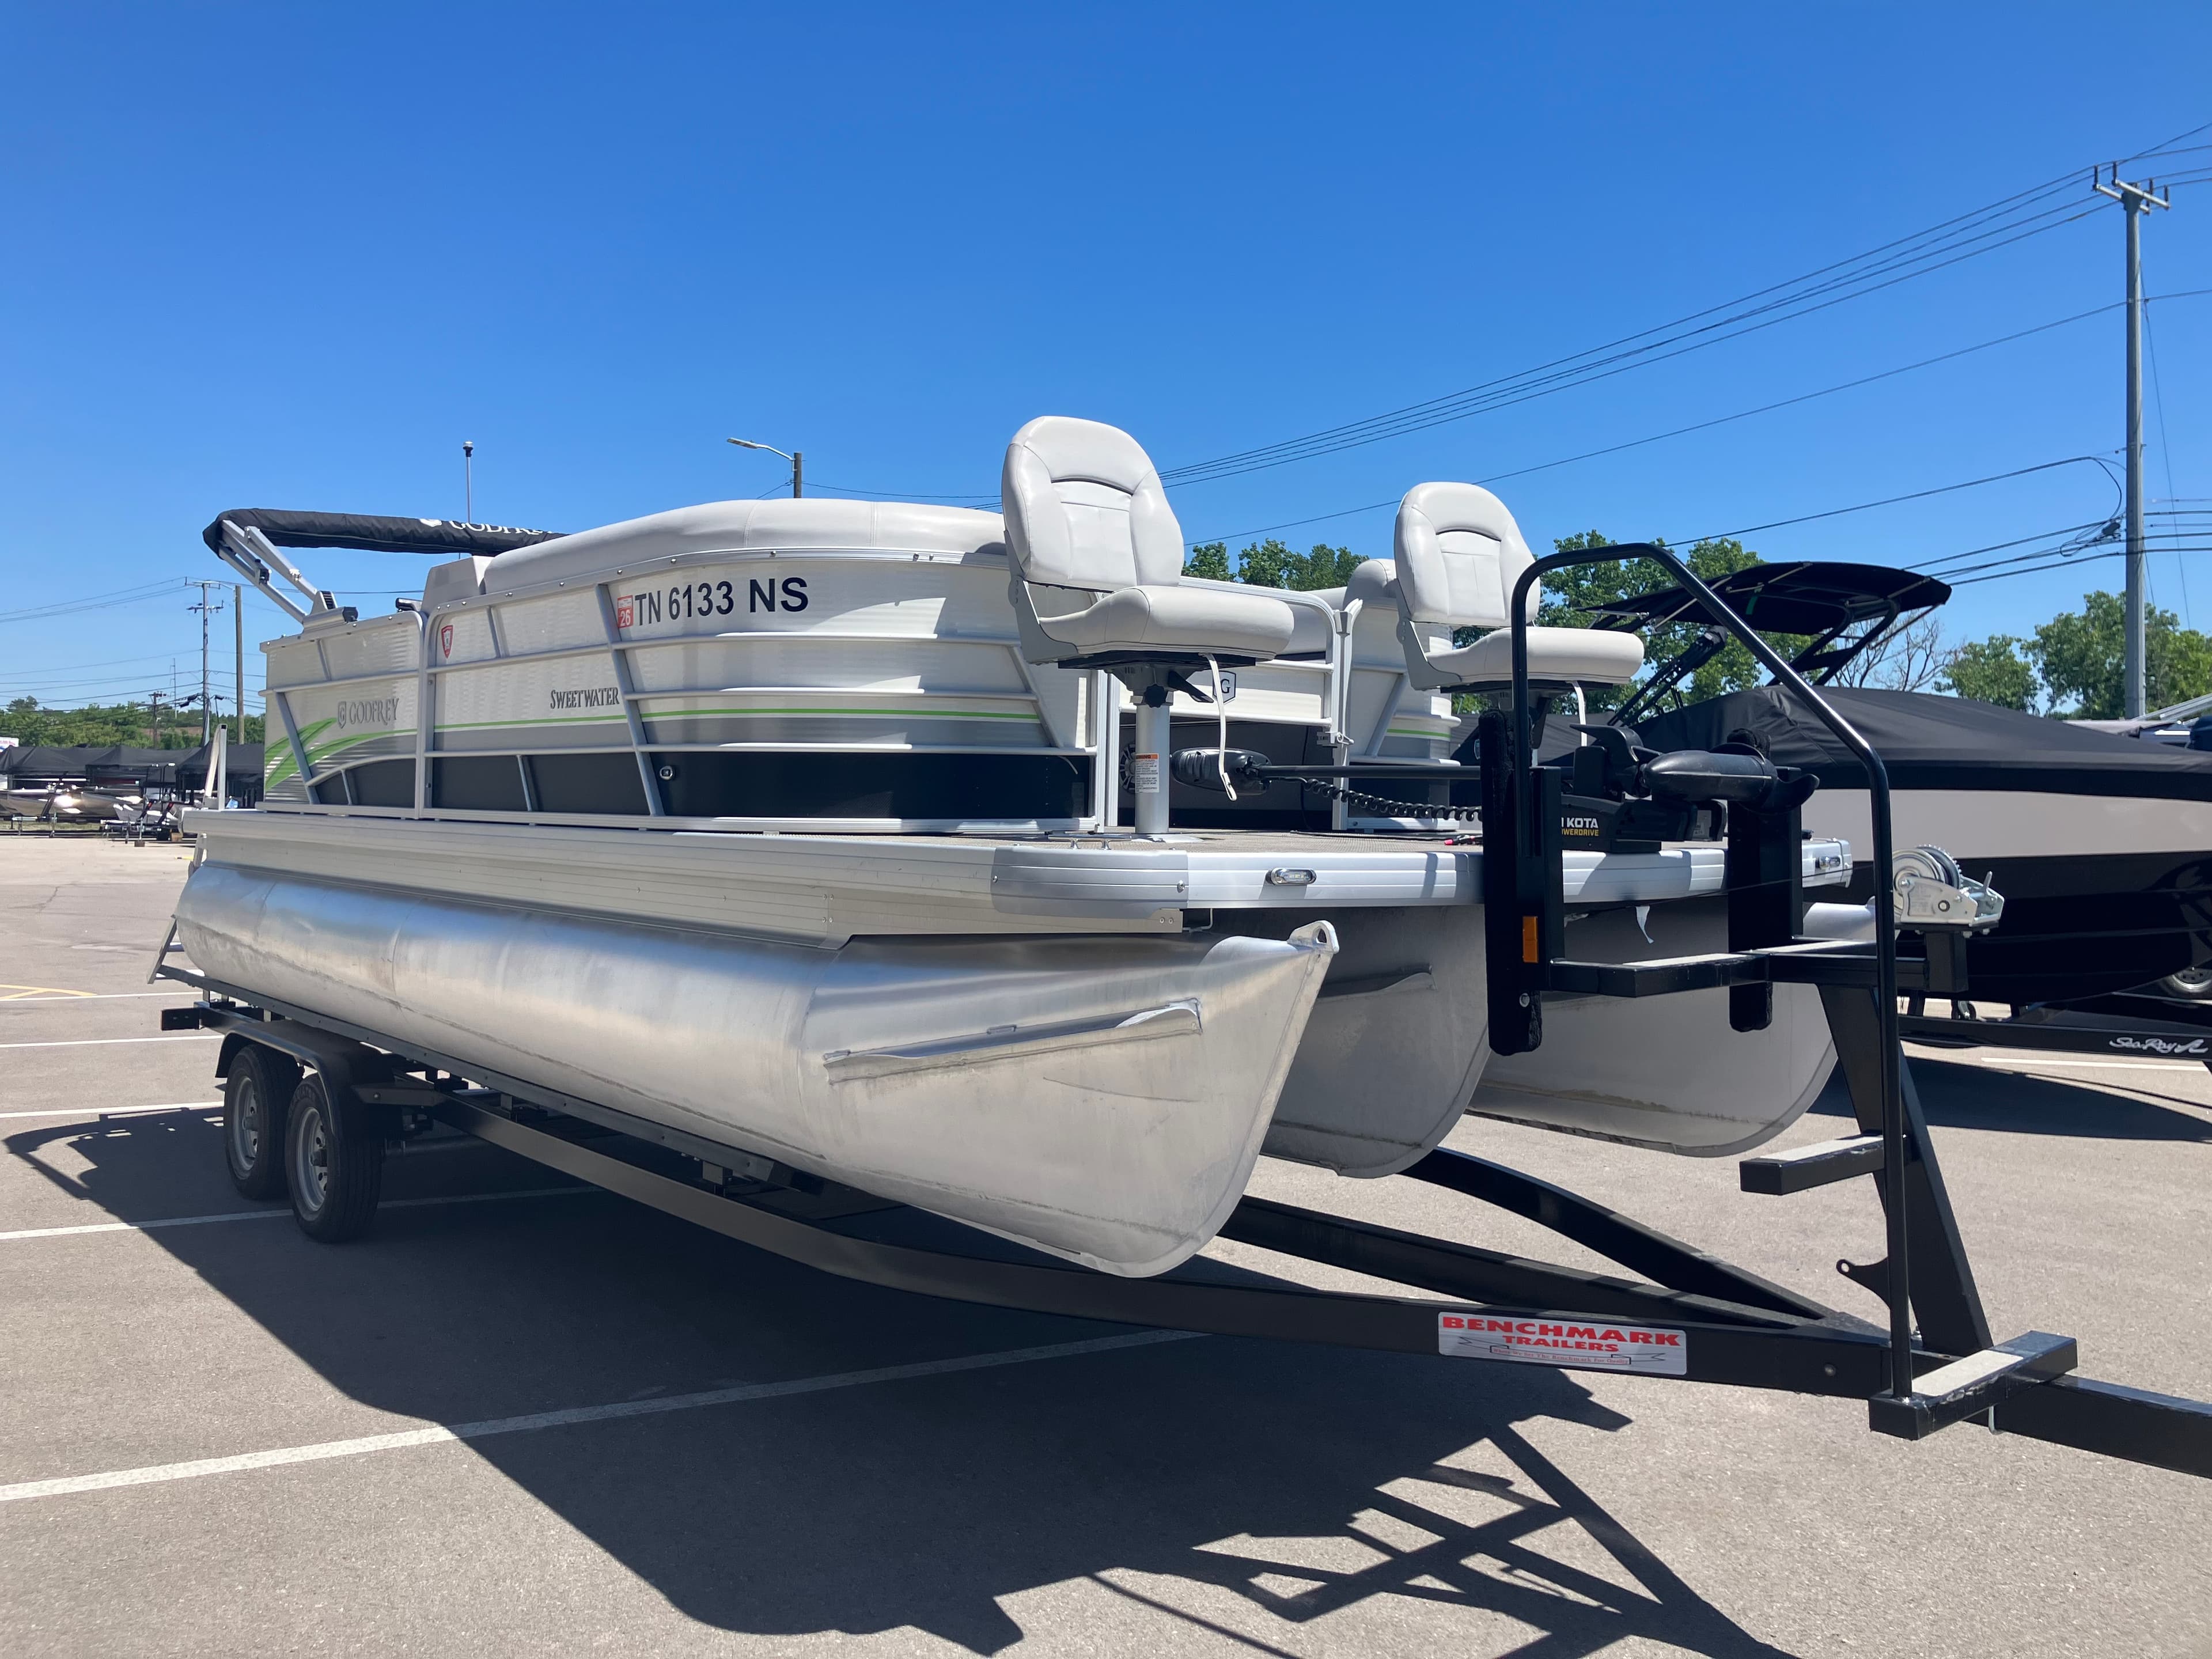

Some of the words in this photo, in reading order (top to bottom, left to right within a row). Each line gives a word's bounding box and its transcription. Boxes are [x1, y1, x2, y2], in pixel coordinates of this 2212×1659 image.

[635, 590, 661, 626] TN
[669, 581, 734, 620] 6133
[749, 577, 808, 613] NS
[620, 609, 631, 626] 26
[550, 687, 620, 709] SWEETWATER
[350, 698, 399, 725] GODFREY
[1562, 828, 1599, 836] WERDRIVE
[1567, 817, 1599, 828] KOTA
[1442, 1316, 1680, 1346] BENCHMARK
[1502, 1335, 1619, 1352] TRAILERS
